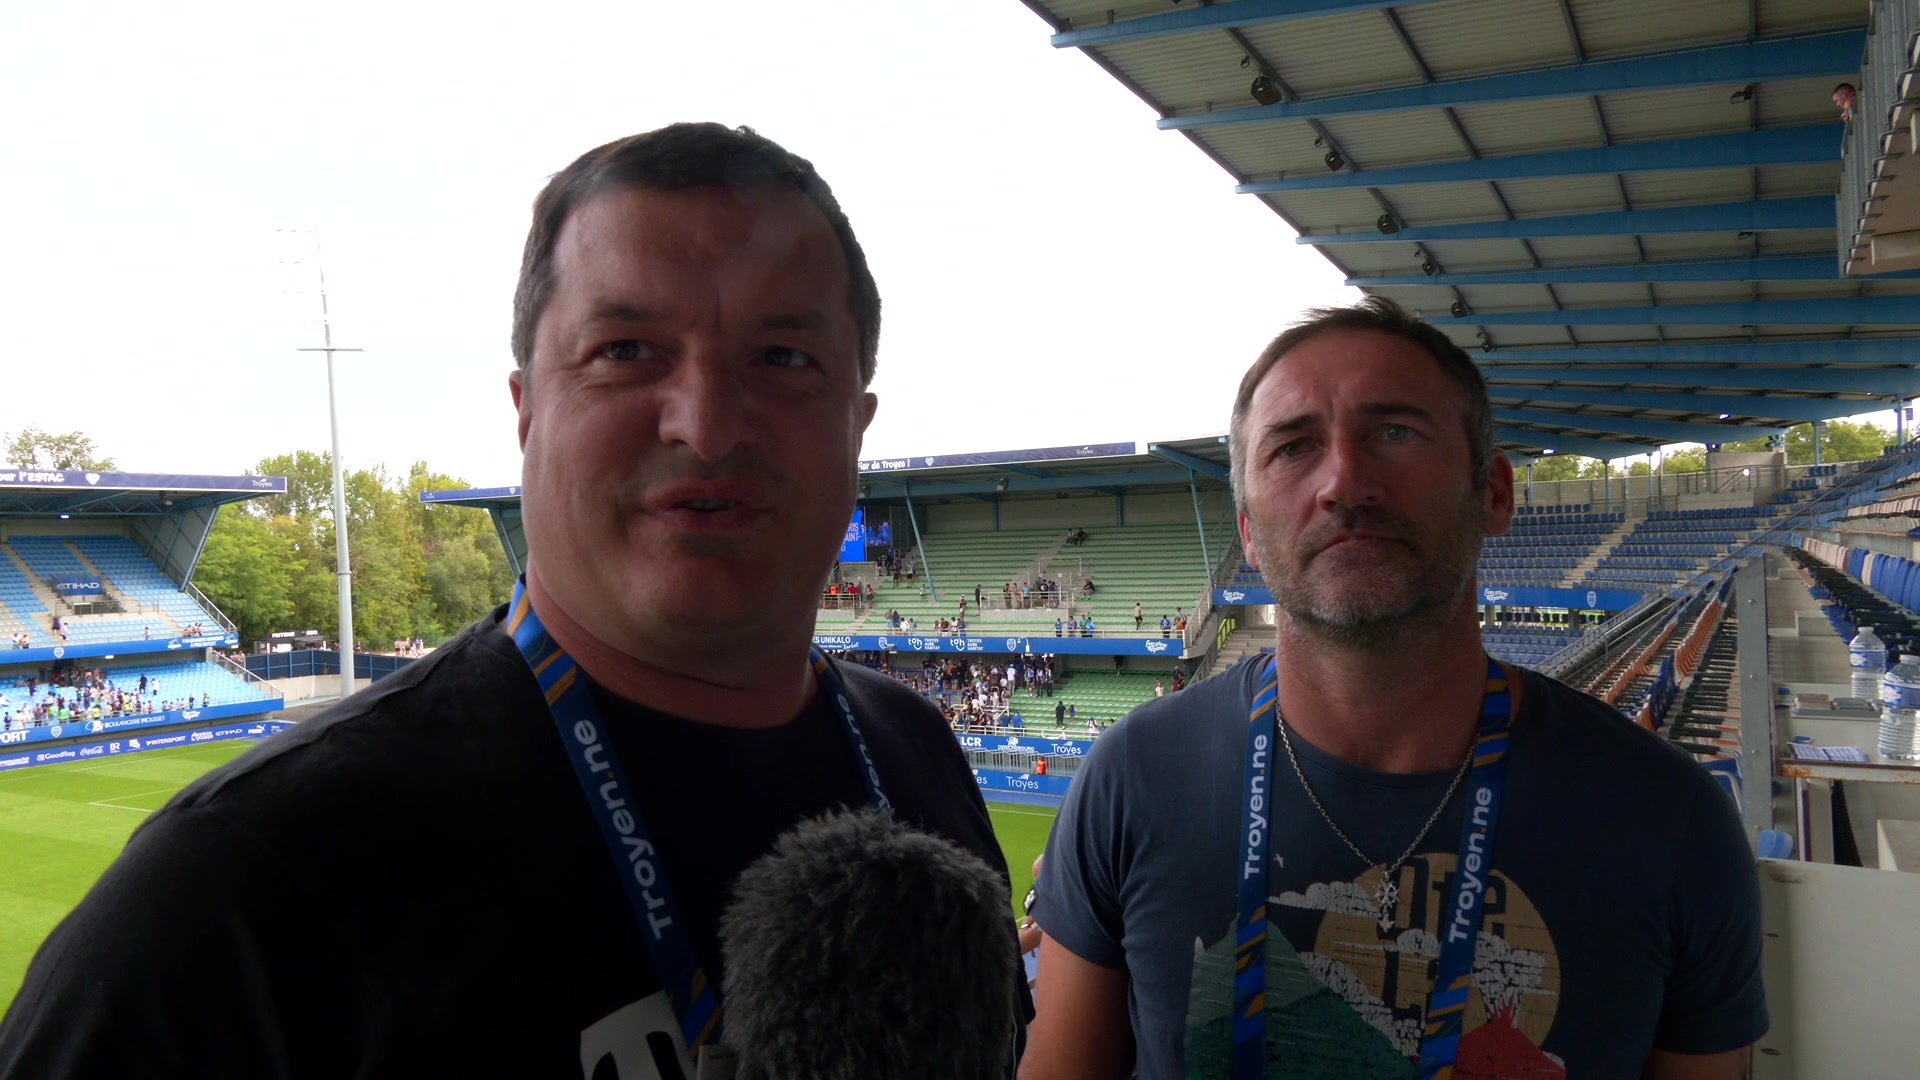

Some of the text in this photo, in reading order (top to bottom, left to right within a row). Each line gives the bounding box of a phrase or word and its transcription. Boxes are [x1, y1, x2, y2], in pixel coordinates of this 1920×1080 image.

[871, 461, 880, 470] de
[881, 460, 906, 470] Troyes
[251, 480, 272, 488] Troyes
[56, 581, 99, 590] ETIHAD
[820, 636, 851, 644] UNIKALO
[104, 715, 165, 729] BOULANGERIE MOUSSET
[215, 728, 243, 737] ETIHAD
[151, 735, 186, 746] INTERSPORT
[961, 736, 982, 747] LCR
[79, 745, 105, 757] Coca-Cola
[110, 742, 120, 751] BR
[1051, 743, 1082, 755] Troyes
[1006, 775, 1039, 791] Troyes
[1243, 733, 1269, 880] Troyen.ne
[573, 718, 672, 940] Troyen.ne
[1448, 786, 1492, 944] Troyen.ne
